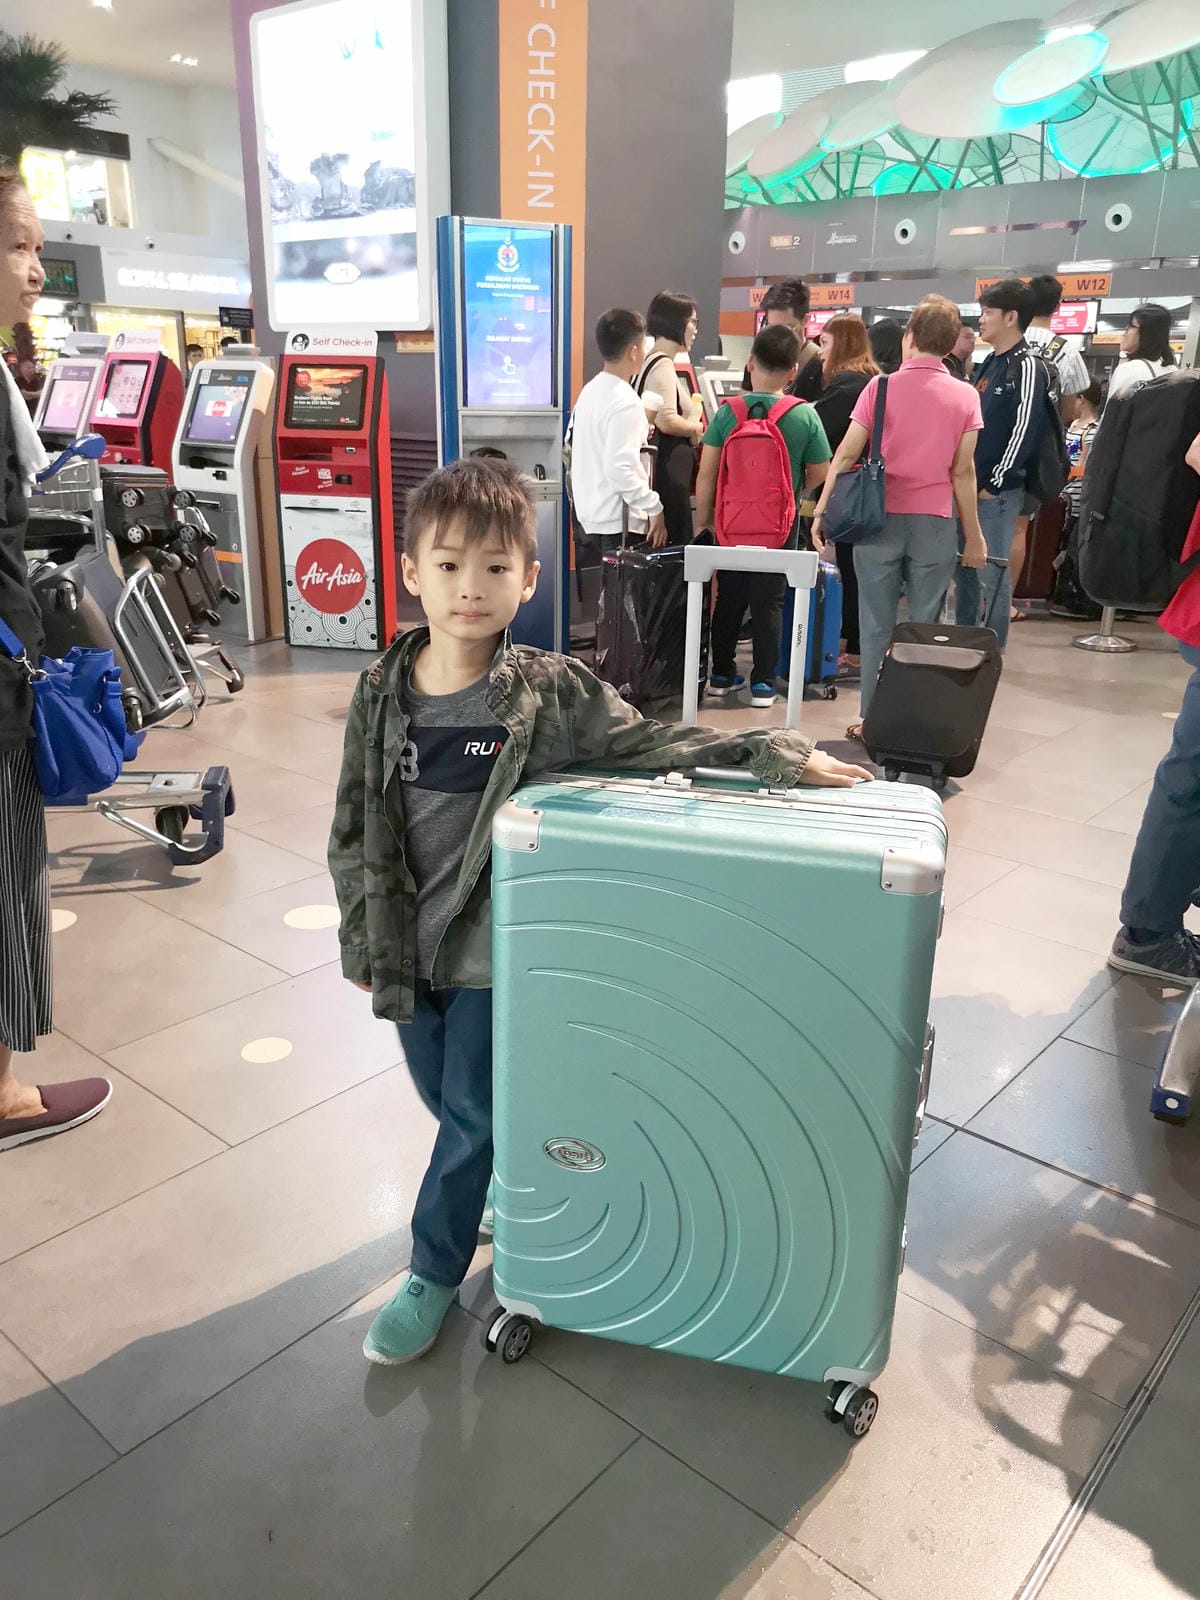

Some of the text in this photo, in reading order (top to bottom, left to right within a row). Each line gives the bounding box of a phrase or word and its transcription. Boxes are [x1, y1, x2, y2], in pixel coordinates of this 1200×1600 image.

[527, 23, 556, 208] CHECK-IN
[793, 235, 801, 245] 2
[1077, 278, 1106, 291] W12
[827, 289, 850, 300] W14
[312, 337, 372, 346] Self Check-in
